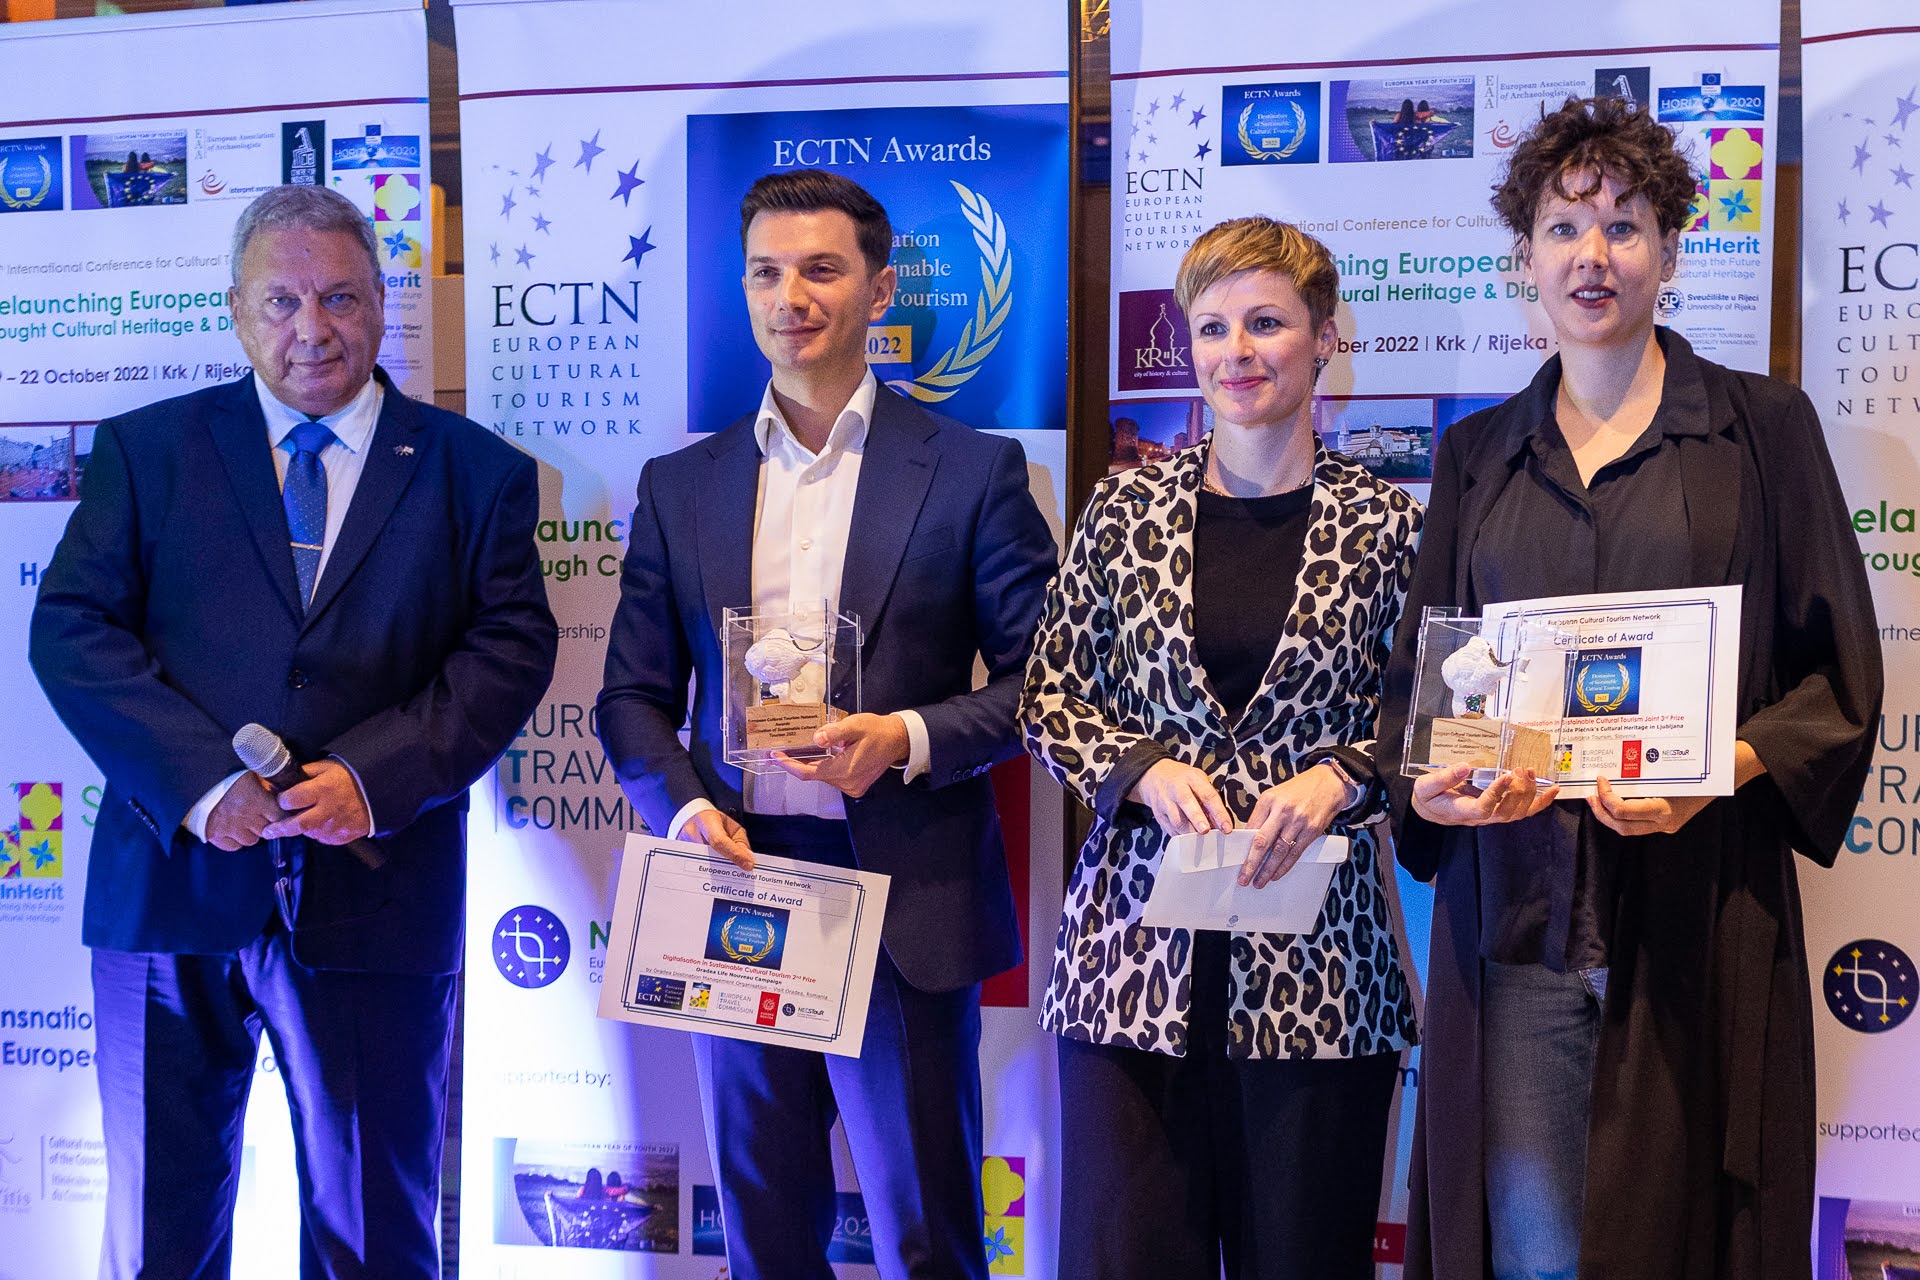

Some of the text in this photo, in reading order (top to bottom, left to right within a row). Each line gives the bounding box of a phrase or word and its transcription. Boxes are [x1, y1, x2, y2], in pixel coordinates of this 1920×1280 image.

[1500, 78, 1586, 92] European Association
[1244, 89, 1301, 99] ECTN Awards
[1500, 91, 1508, 100] of
[1731, 97, 1762, 108] 2020
[390, 145, 417, 157] 2020
[773, 135, 991, 167] ECTN Awards
[1126, 168, 1203, 194] ECTN
[1126, 195, 1202, 207] EUROPEAN
[1125, 210, 1202, 222] CULTURAL
[1343, 216, 1451, 232] Conference for
[1125, 225, 1202, 237] TOURISM
[7, 255, 218, 275] International Conference for Cultural
[1710, 257, 1761, 267] the Future
[1714, 270, 1756, 280] Heritage
[1387, 284, 1476, 304] Heritage
[1484, 283, 1498, 300] &
[492, 281, 642, 327] ECTN
[1687, 302, 1723, 312] University
[52, 319, 117, 338] Cultural
[122, 317, 194, 336] Heritage
[200, 317, 211, 332] &
[493, 334, 640, 353] EUROPEAN
[864, 336, 902, 356] 022
[1375, 336, 1419, 352] 2022
[1436, 335, 1466, 351] Krk
[1488, 334, 1548, 354] Rijeka
[20, 370, 39, 385] 22
[44, 367, 110, 384] October
[113, 365, 149, 382] 2022
[162, 364, 187, 380] Krk
[492, 362, 641, 381] CULTURAL
[492, 391, 641, 409] TOURISM
[493, 419, 642, 436] NETWORK
[1580, 613, 1661, 624] Cultural Tourism Network
[1607, 631, 1654, 642] of Award
[1581, 653, 1627, 662] ECTN Awards
[1657, 723, 1684, 731] Ljubljana
[698, 865, 812, 889] European Cultural Tourism Network
[0, 882, 64, 900] InHerit
[702, 882, 803, 907] Certificate of Award
[730, 905, 775, 918] ECTN Awards
[662, 954, 701, 966] Digitalisation
[709, 961, 743, 972] Sustainable
[745, 966, 768, 975] Cultural
[769, 971, 791, 979] Tourism
[802, 976, 817, 984] Prize
[729, 972, 753, 981] Nouveau
[755, 976, 782, 985] Campaign
[637, 992, 661, 1002] ECTN
[719, 998, 741, 1006] TRAVEL
[720, 992, 752, 1002] EUROPEAN
[718, 1004, 754, 1014] COMMISSION
[2, 1042, 98, 1071] Europe
